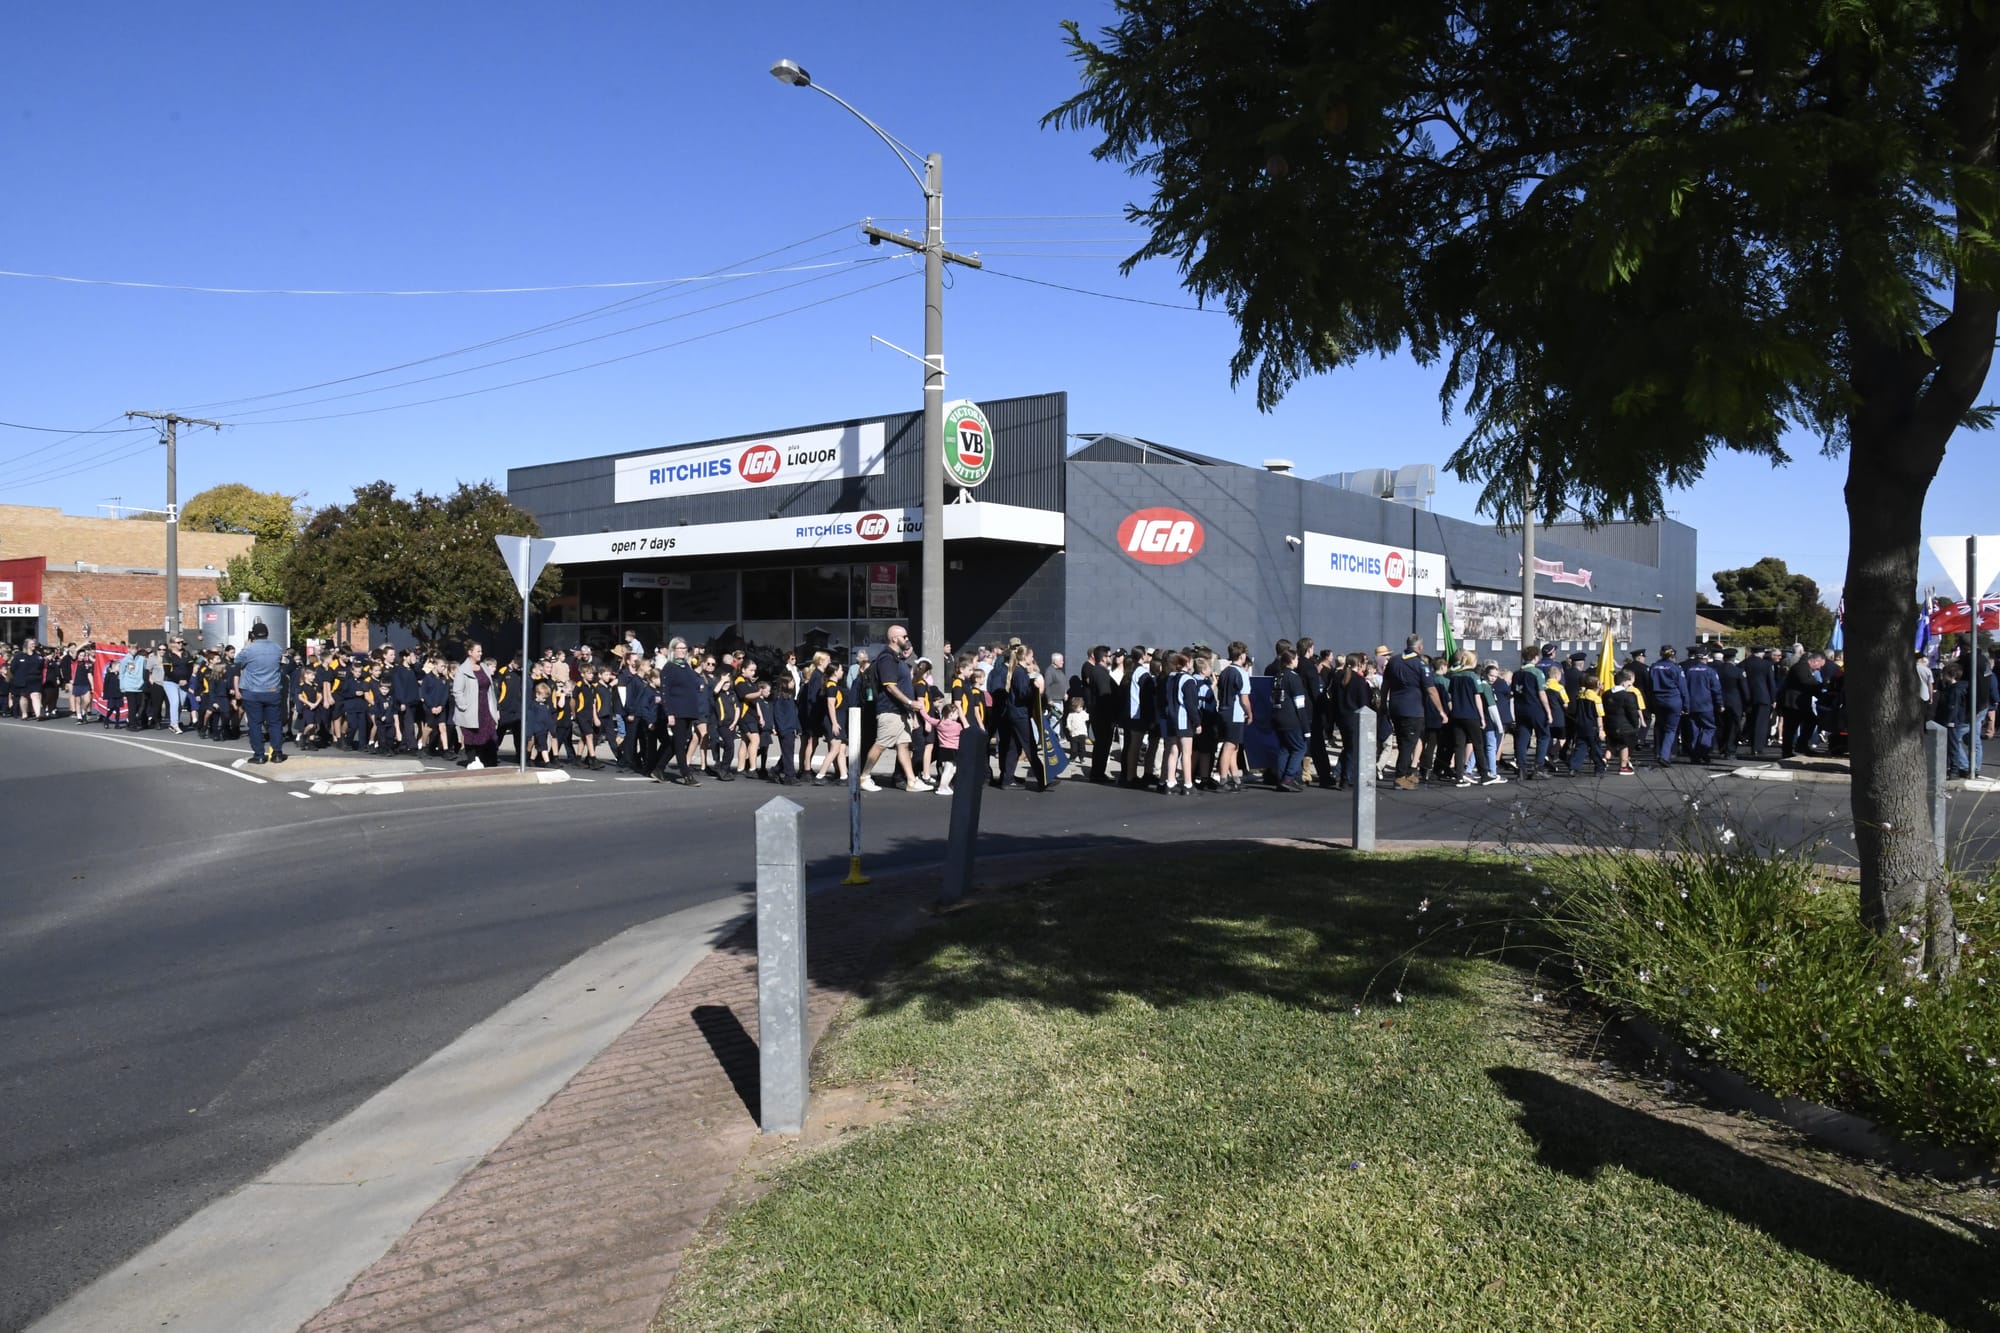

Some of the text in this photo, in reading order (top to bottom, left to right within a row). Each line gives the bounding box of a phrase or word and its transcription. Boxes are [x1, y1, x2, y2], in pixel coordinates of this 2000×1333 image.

[949, 406, 986, 429] VICTORIA
[788, 444, 800, 452] plus
[960, 431, 984, 454] VB
[650, 449, 836, 485] RITCHIES IGA LIQUOR
[953, 461, 985, 479] BITTER
[796, 523, 852, 538] RITCHIES
[860, 518, 886, 536] IGA
[1127, 519, 1194, 554] IGA
[611, 537, 676, 554] open 7 days
[1331, 552, 1429, 580] RITCHIES IGA LIUOR
[0, 606, 31, 615] CHER
